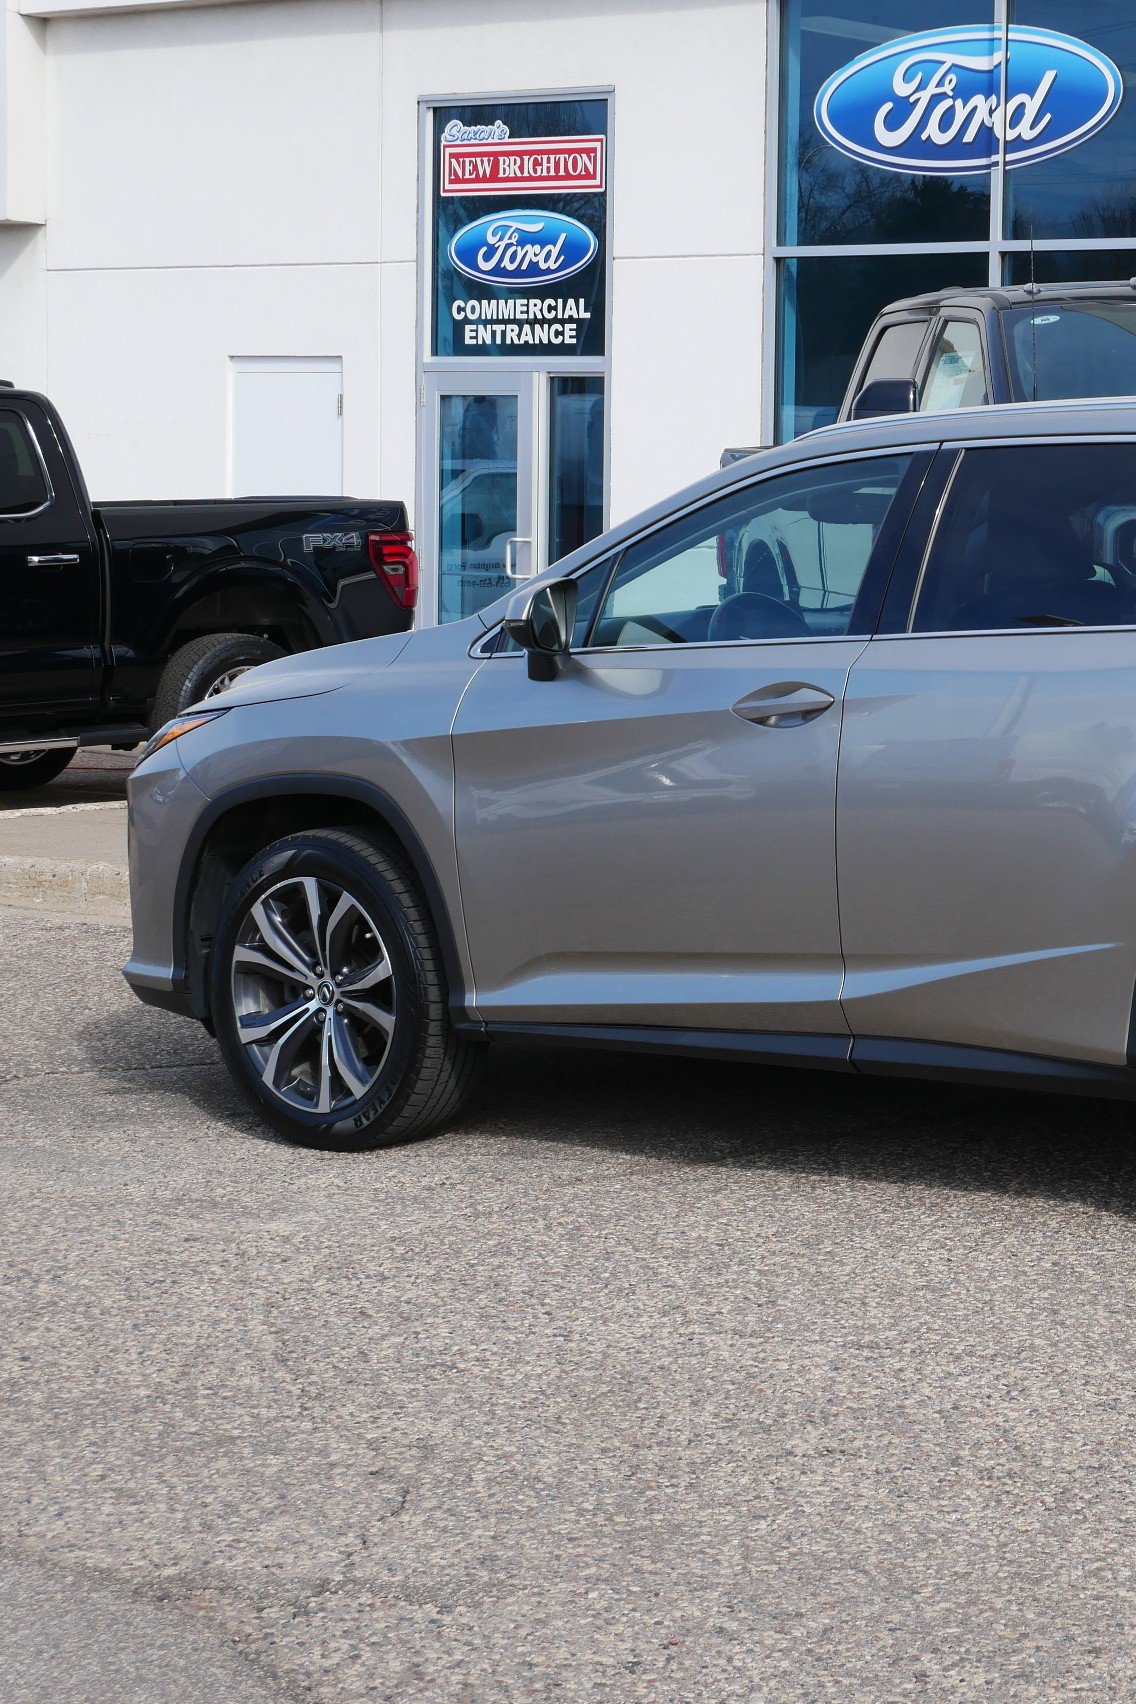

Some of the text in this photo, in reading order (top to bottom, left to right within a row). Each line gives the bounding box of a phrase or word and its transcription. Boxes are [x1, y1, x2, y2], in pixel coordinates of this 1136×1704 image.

[874, 50, 1058, 147] Ford
[443, 122, 507, 143] Saxon's
[450, 152, 596, 180] NEW BRIGHTON
[477, 220, 568, 272] Ford
[451, 298, 591, 320] COMMERCIAL
[464, 323, 577, 345] ENTRANCE
[303, 532, 362, 553] FX4
